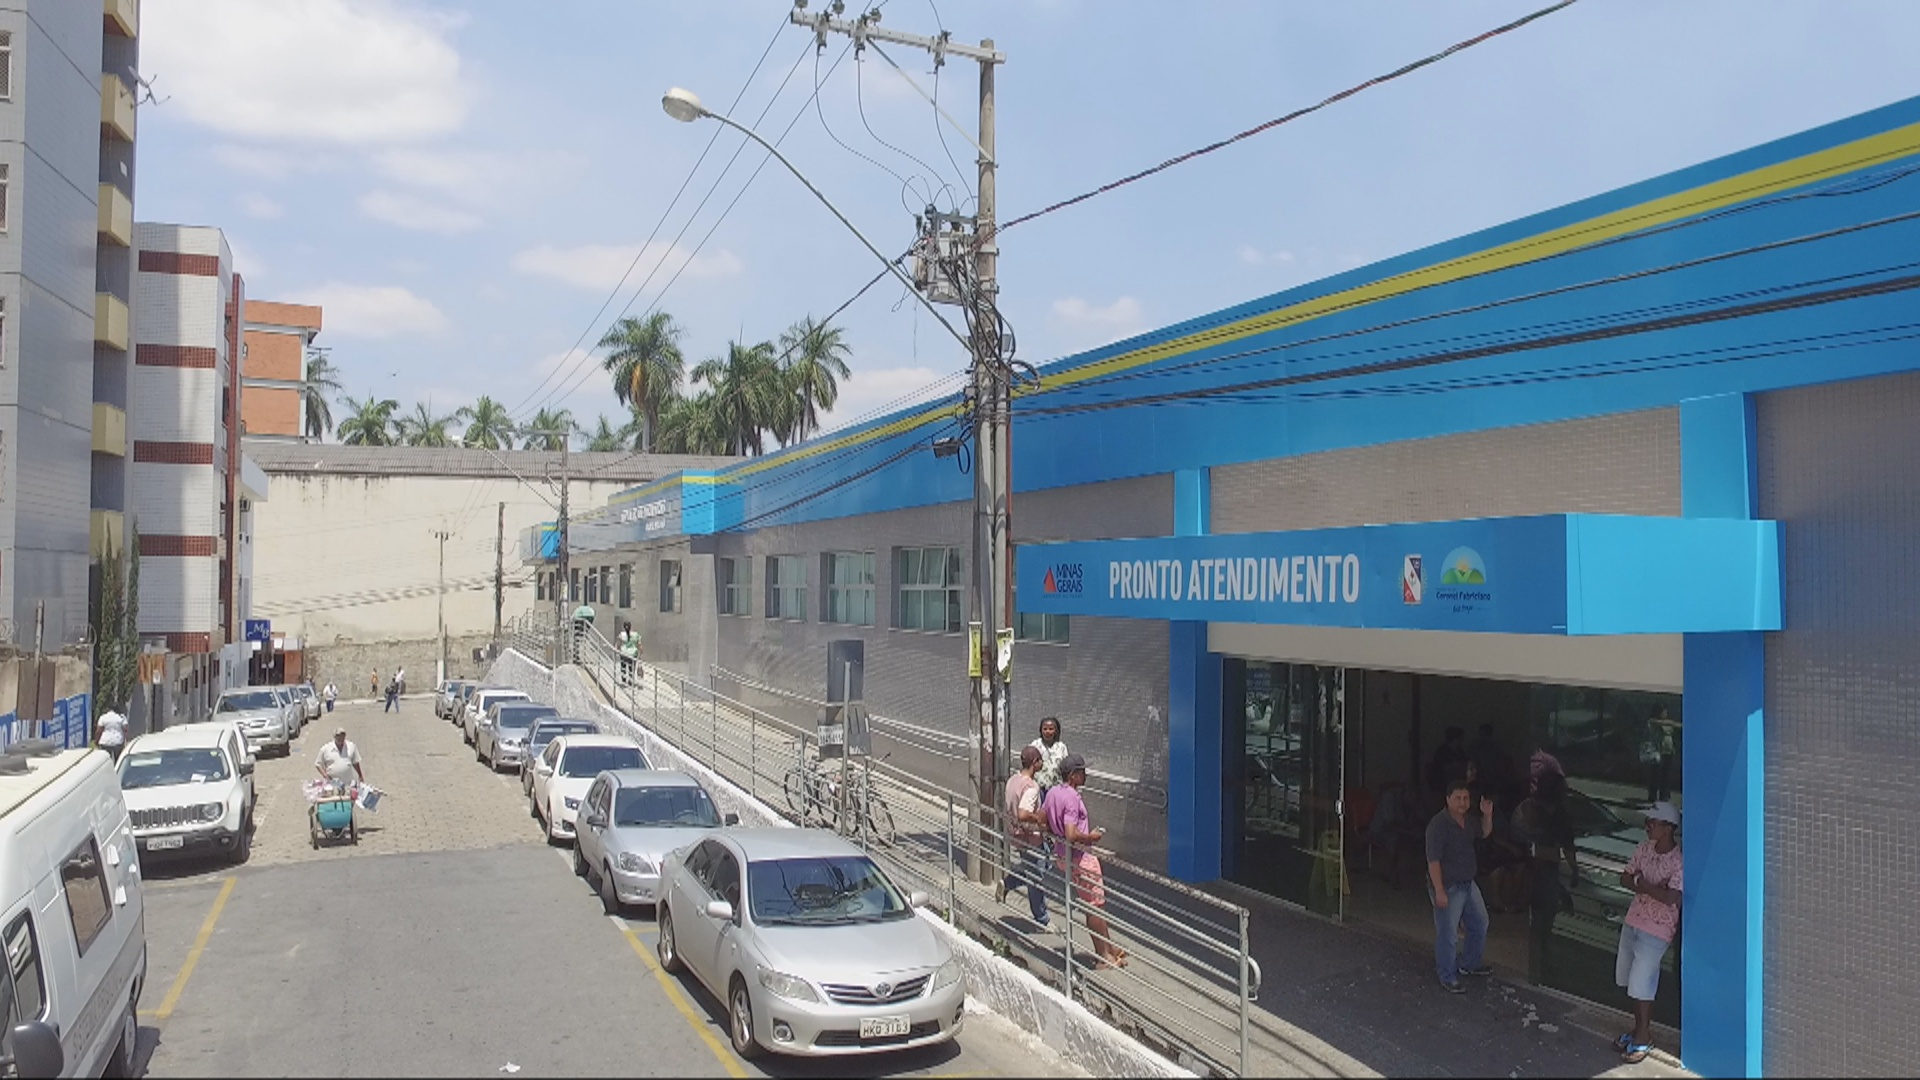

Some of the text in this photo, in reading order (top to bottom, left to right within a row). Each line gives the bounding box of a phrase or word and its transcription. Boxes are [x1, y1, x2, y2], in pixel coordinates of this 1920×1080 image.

[1056, 563, 1084, 579] MINAS
[1109, 553, 1360, 603] PRONTO ATENDIMENTO
[1056, 579, 1084, 593] GERAIS
